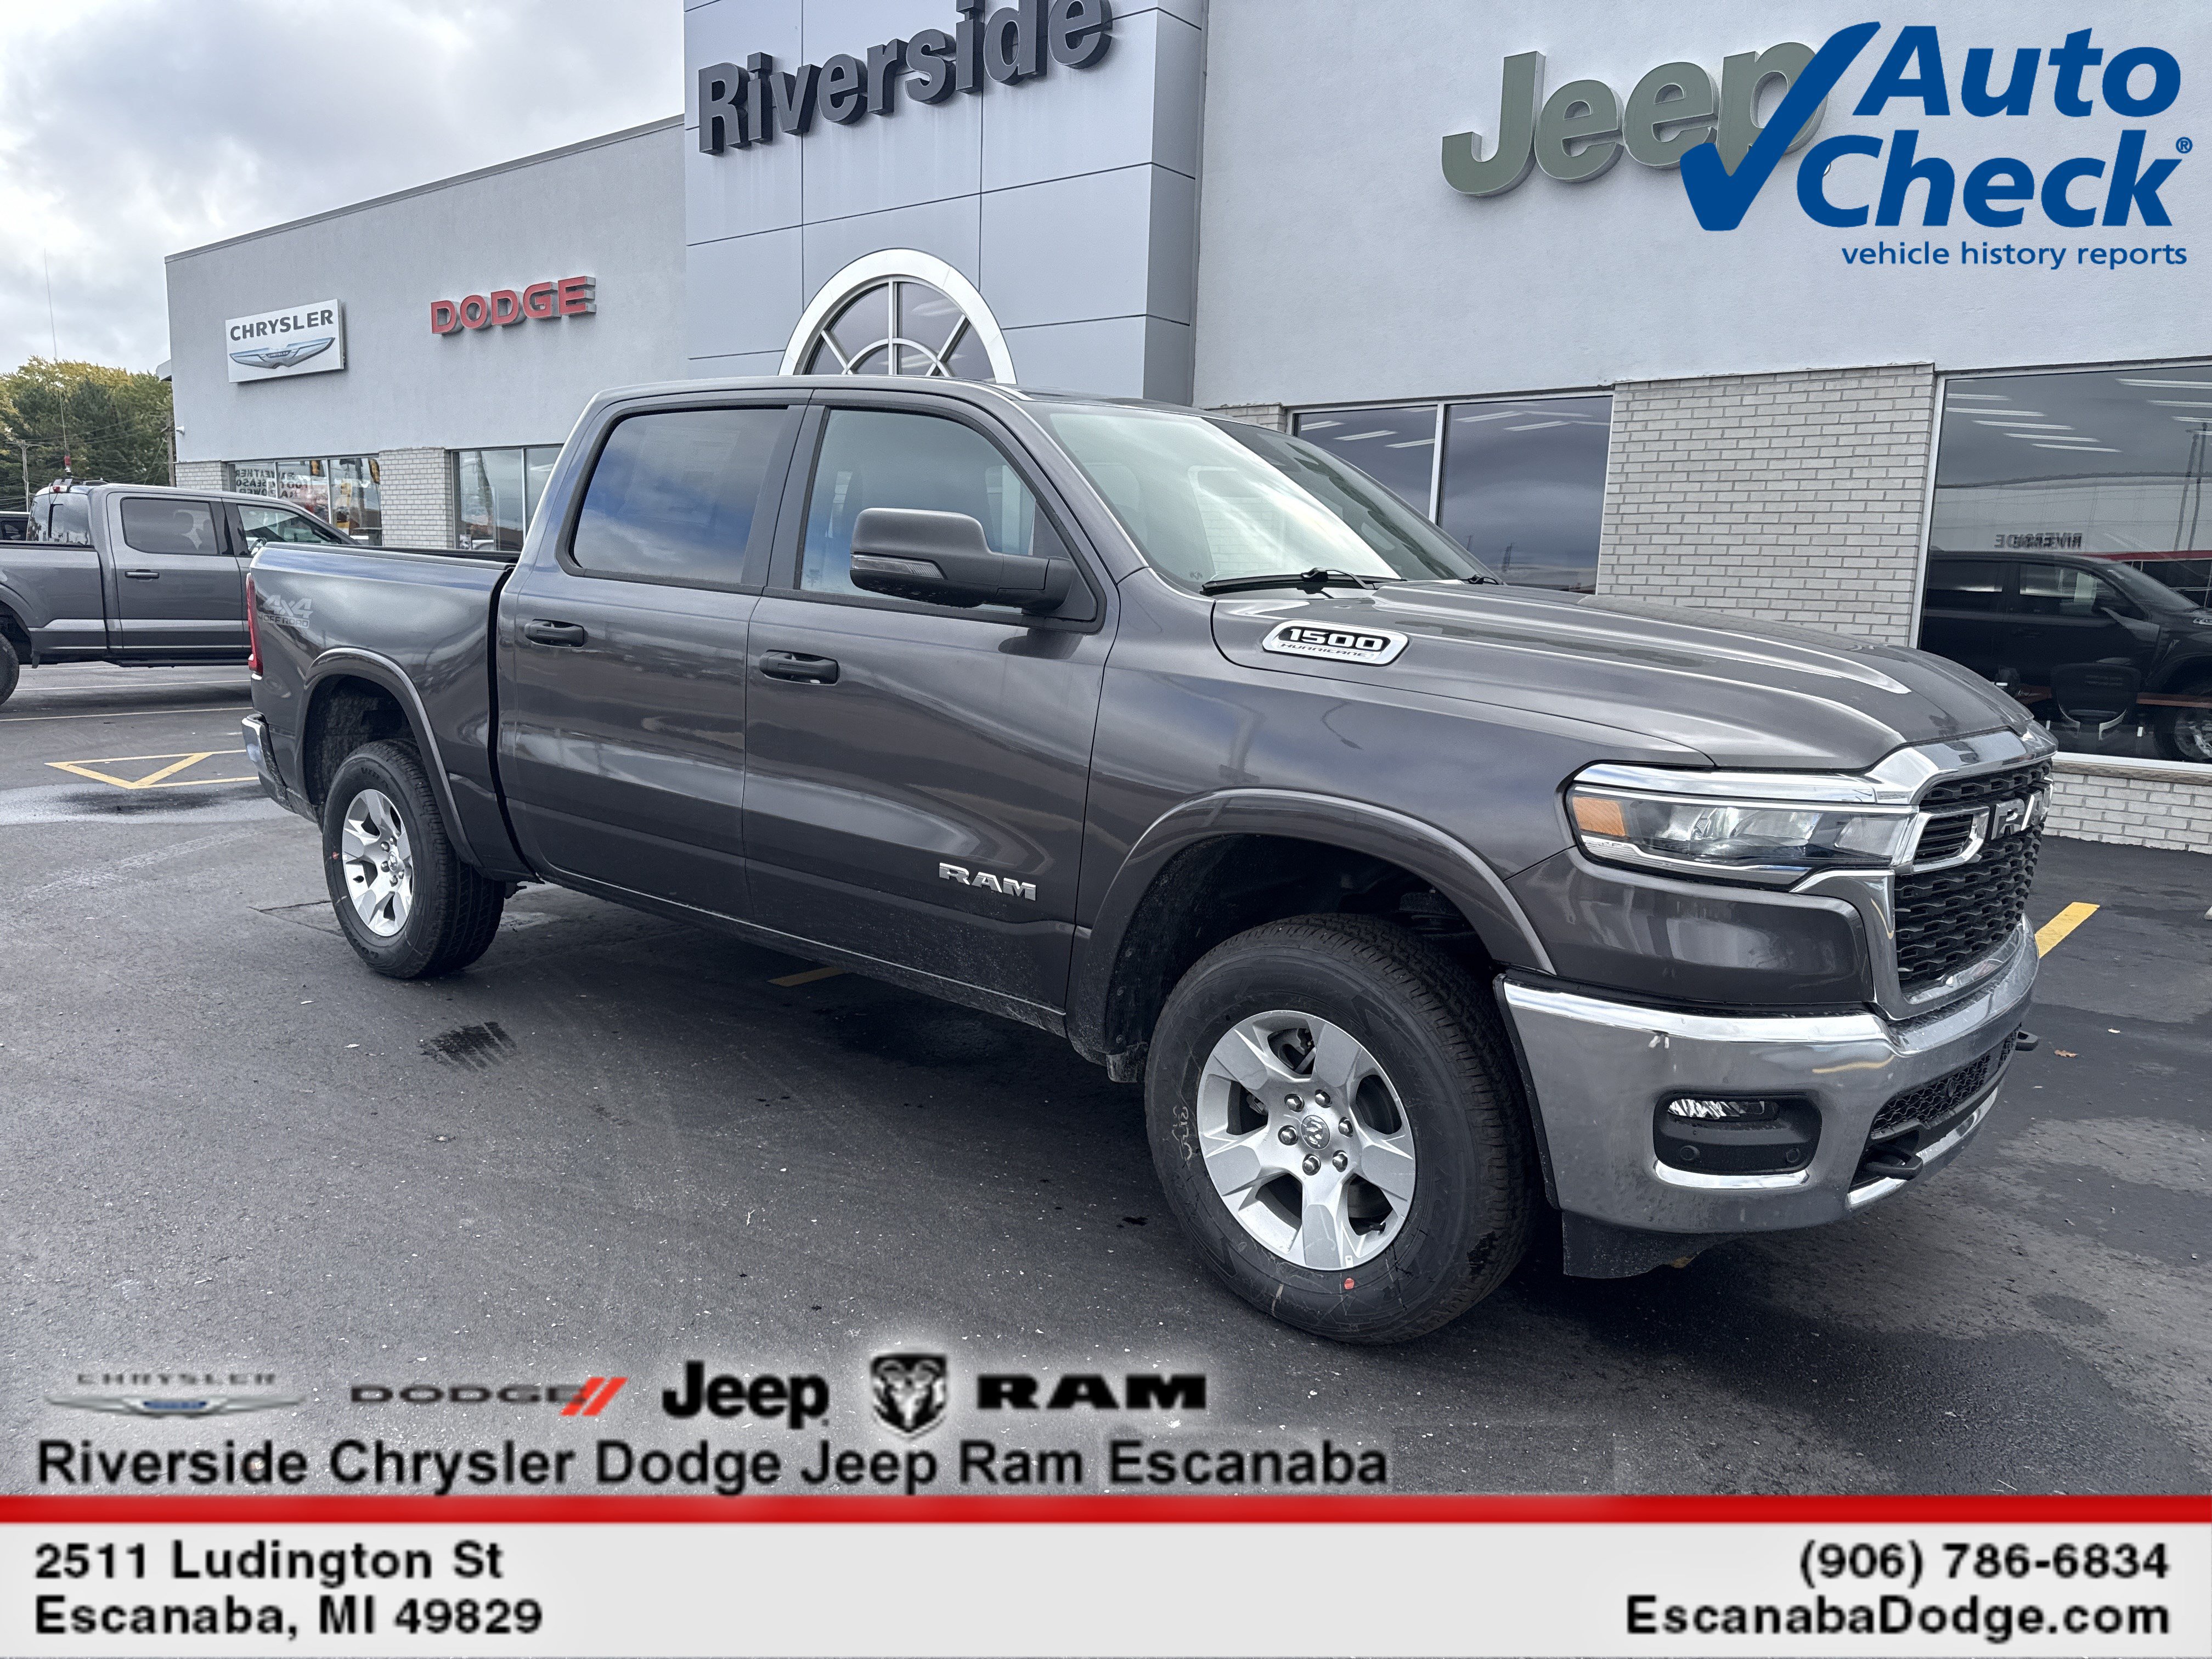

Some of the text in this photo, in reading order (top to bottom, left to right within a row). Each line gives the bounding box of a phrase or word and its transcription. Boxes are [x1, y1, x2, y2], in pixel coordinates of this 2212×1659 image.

[698, 0, 1113, 154] Riverside
[1441, 41, 1828, 198] Jeep
[431, 275, 596, 335] DODGE
[229, 309, 334, 341] CHRYSLER
[1280, 642, 1367, 658] HURRICANE
[1290, 628, 1384, 651] 1500
[939, 862, 1036, 901] RAM
